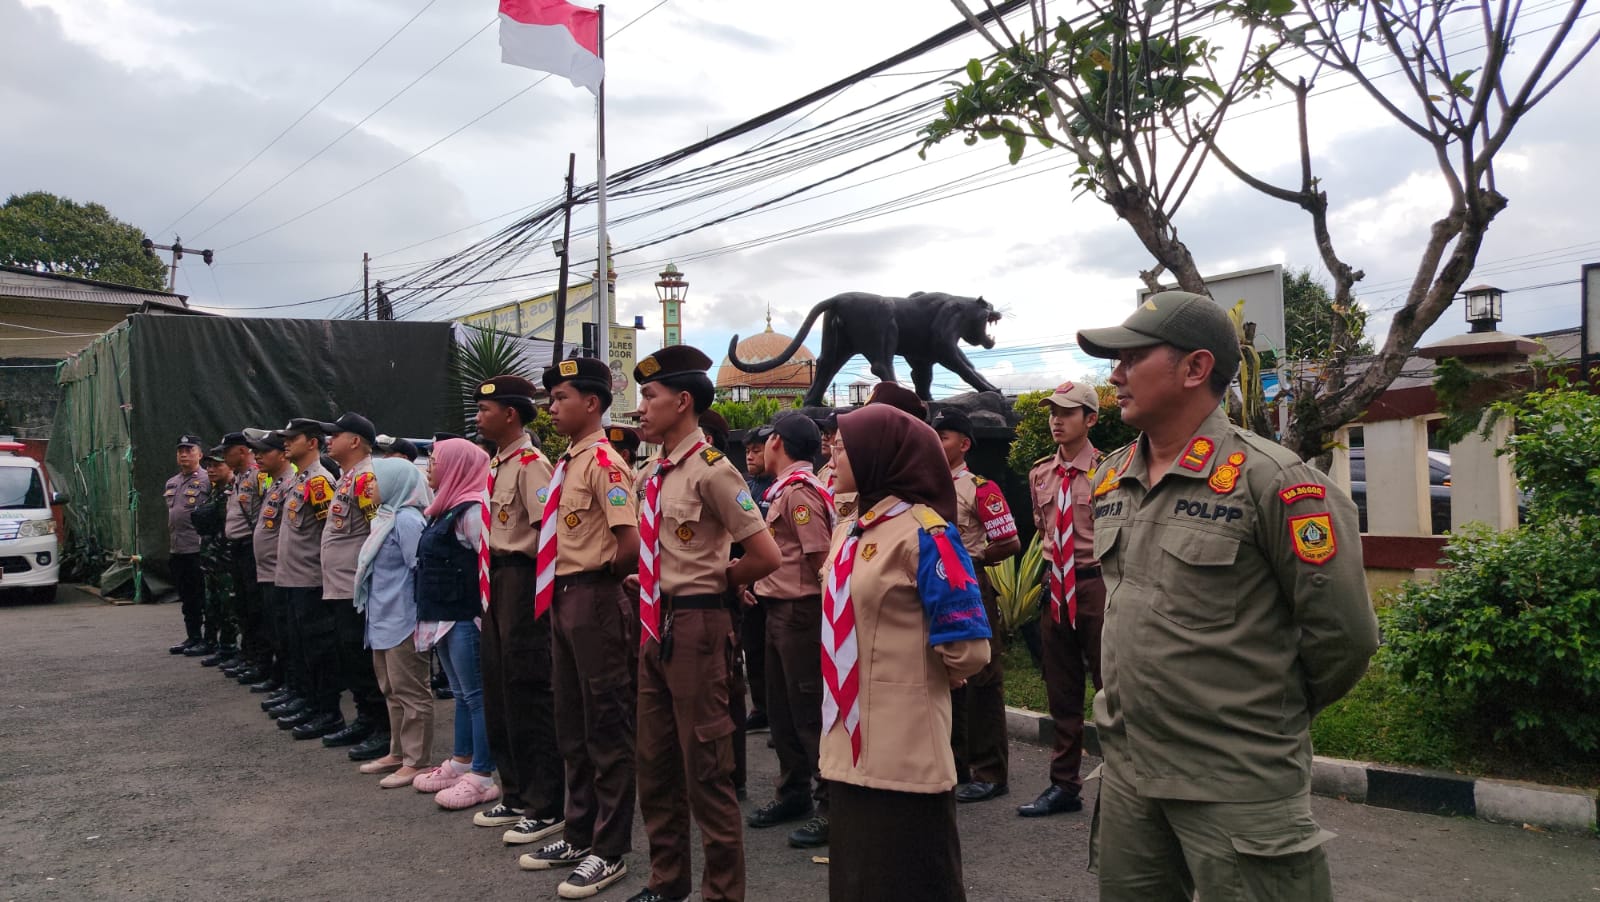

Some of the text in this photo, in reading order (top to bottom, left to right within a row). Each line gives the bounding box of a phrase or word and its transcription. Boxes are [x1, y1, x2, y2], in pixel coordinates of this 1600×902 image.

[608, 340, 633, 350] OLRES
[608, 349, 633, 359] OGOR
[1173, 498, 1243, 523] POLPP
